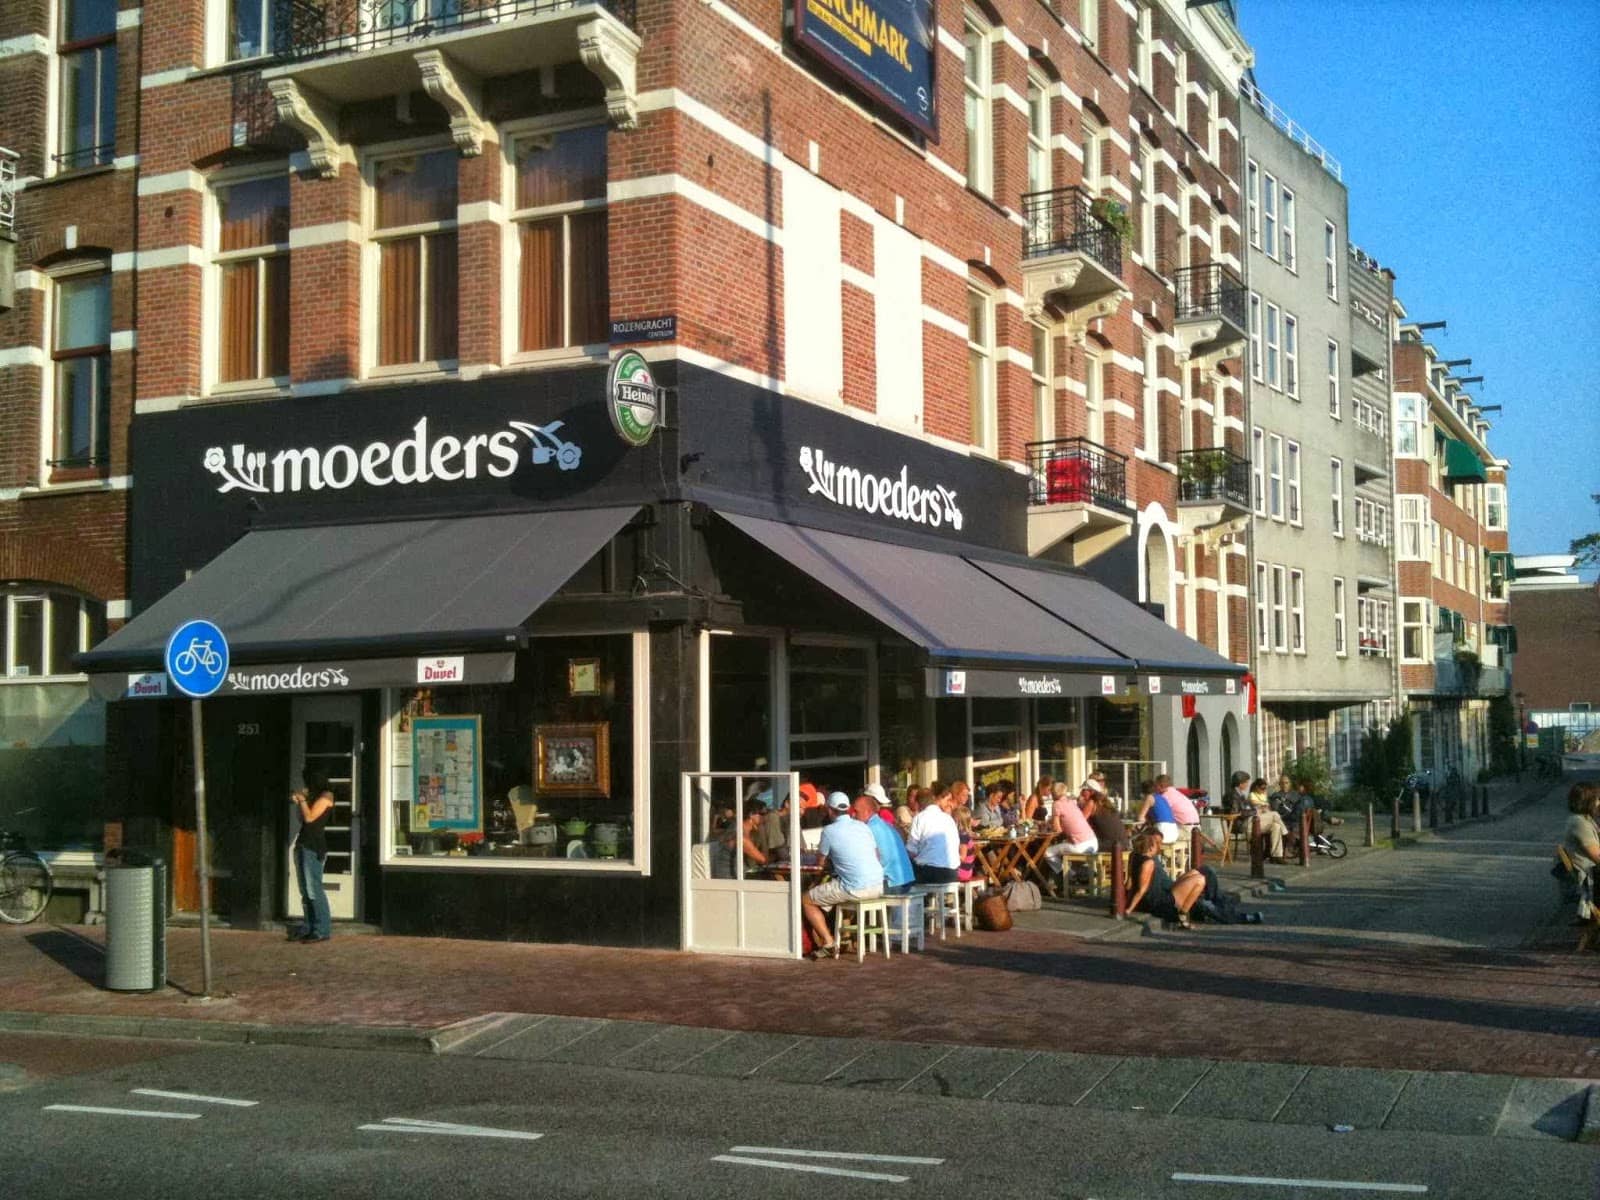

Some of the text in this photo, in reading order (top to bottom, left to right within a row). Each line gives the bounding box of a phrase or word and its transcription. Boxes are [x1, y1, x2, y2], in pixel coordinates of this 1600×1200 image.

[613, 318, 672, 334] ROZENGRACHT
[272, 416, 519, 493] moeders
[837, 464, 942, 527] moeders
[250, 665, 330, 690] moeders
[424, 666, 457, 680] Duvel
